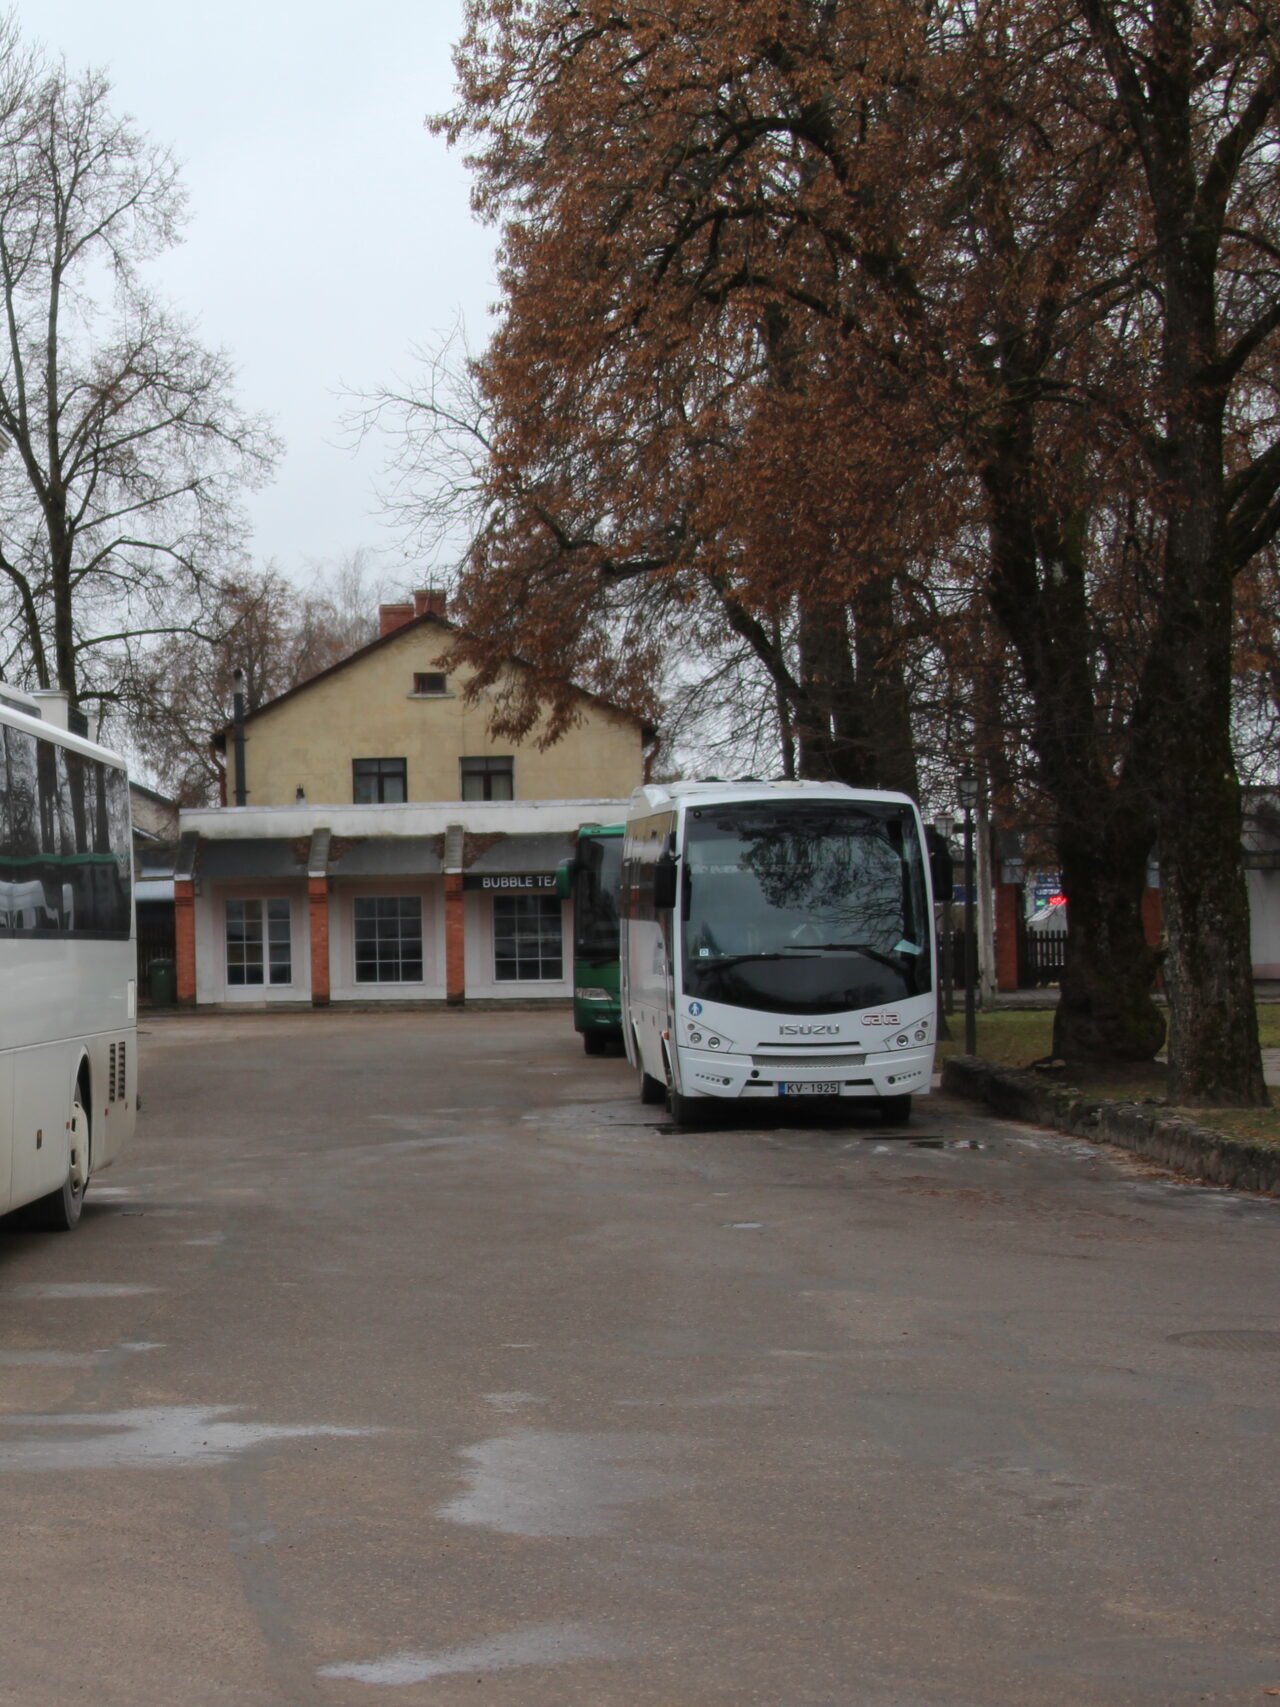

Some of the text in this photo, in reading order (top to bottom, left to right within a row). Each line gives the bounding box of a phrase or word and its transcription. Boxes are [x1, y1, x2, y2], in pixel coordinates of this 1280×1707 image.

[482, 876, 533, 889] BUBBLE
[860, 1009, 901, 1026] cata
[779, 1023, 840, 1036] ISUZU
[786, 1082, 837, 1094] KV-1925
